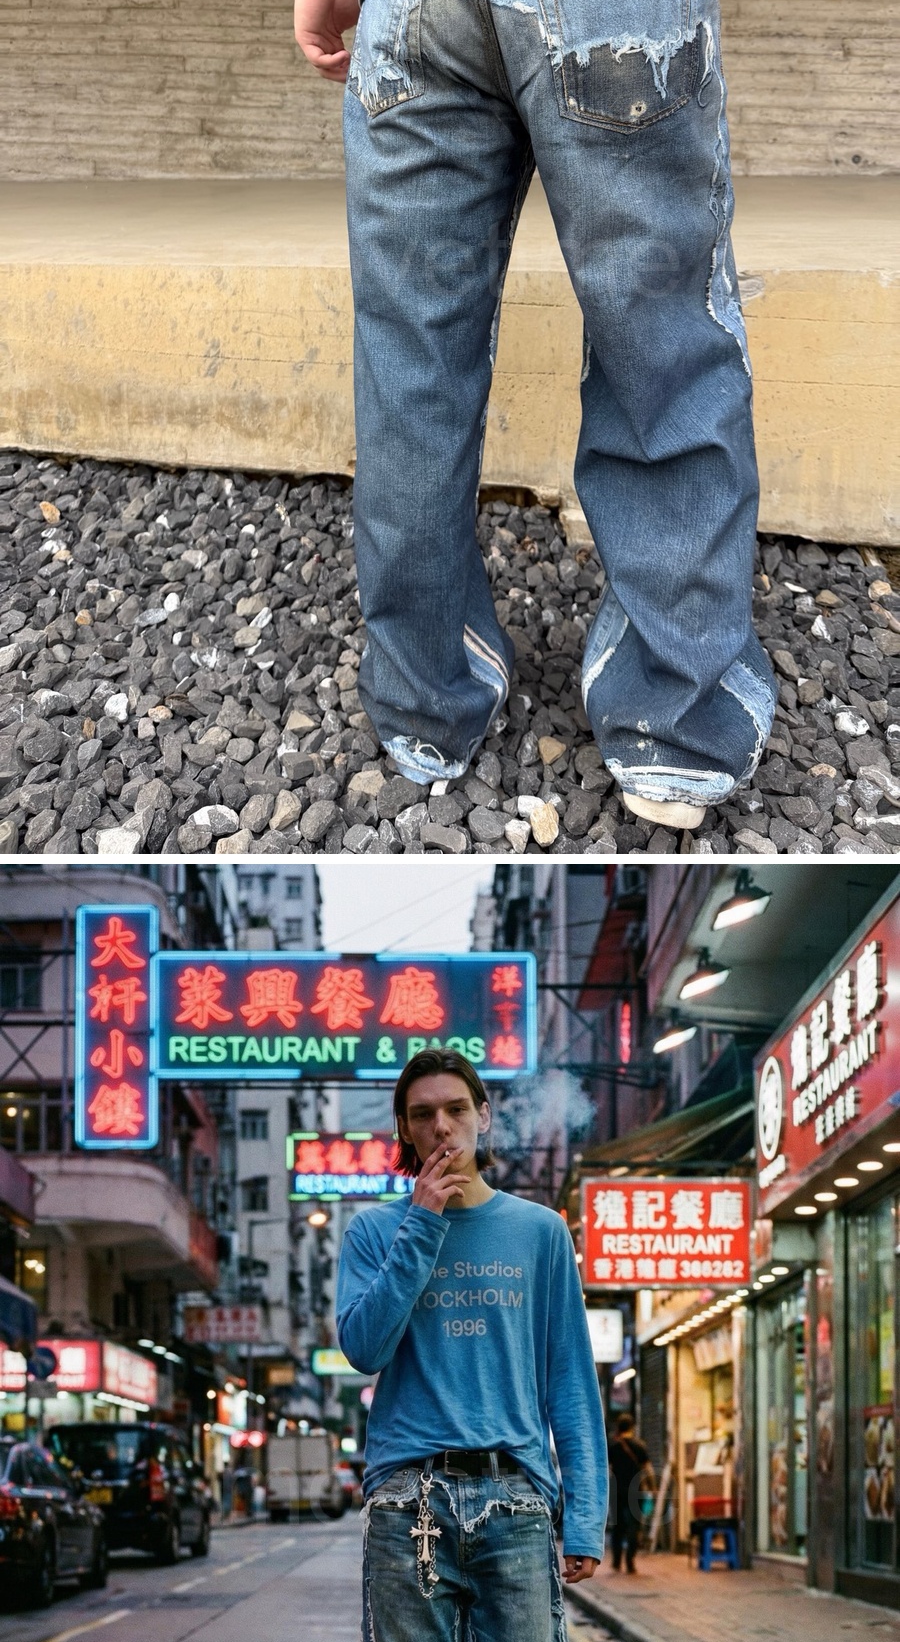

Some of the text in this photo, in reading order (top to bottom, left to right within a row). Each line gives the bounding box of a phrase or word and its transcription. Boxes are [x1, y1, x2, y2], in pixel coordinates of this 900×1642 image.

[168, 1036, 361, 1063] RESTAURANT
[376, 1036, 397, 1063] &
[793, 1019, 877, 1126] RESTAURANT
[602, 1233, 734, 1255] RESTAURANT
[454, 1260, 523, 1278] Studios
[443, 1319, 487, 1337] 1996
